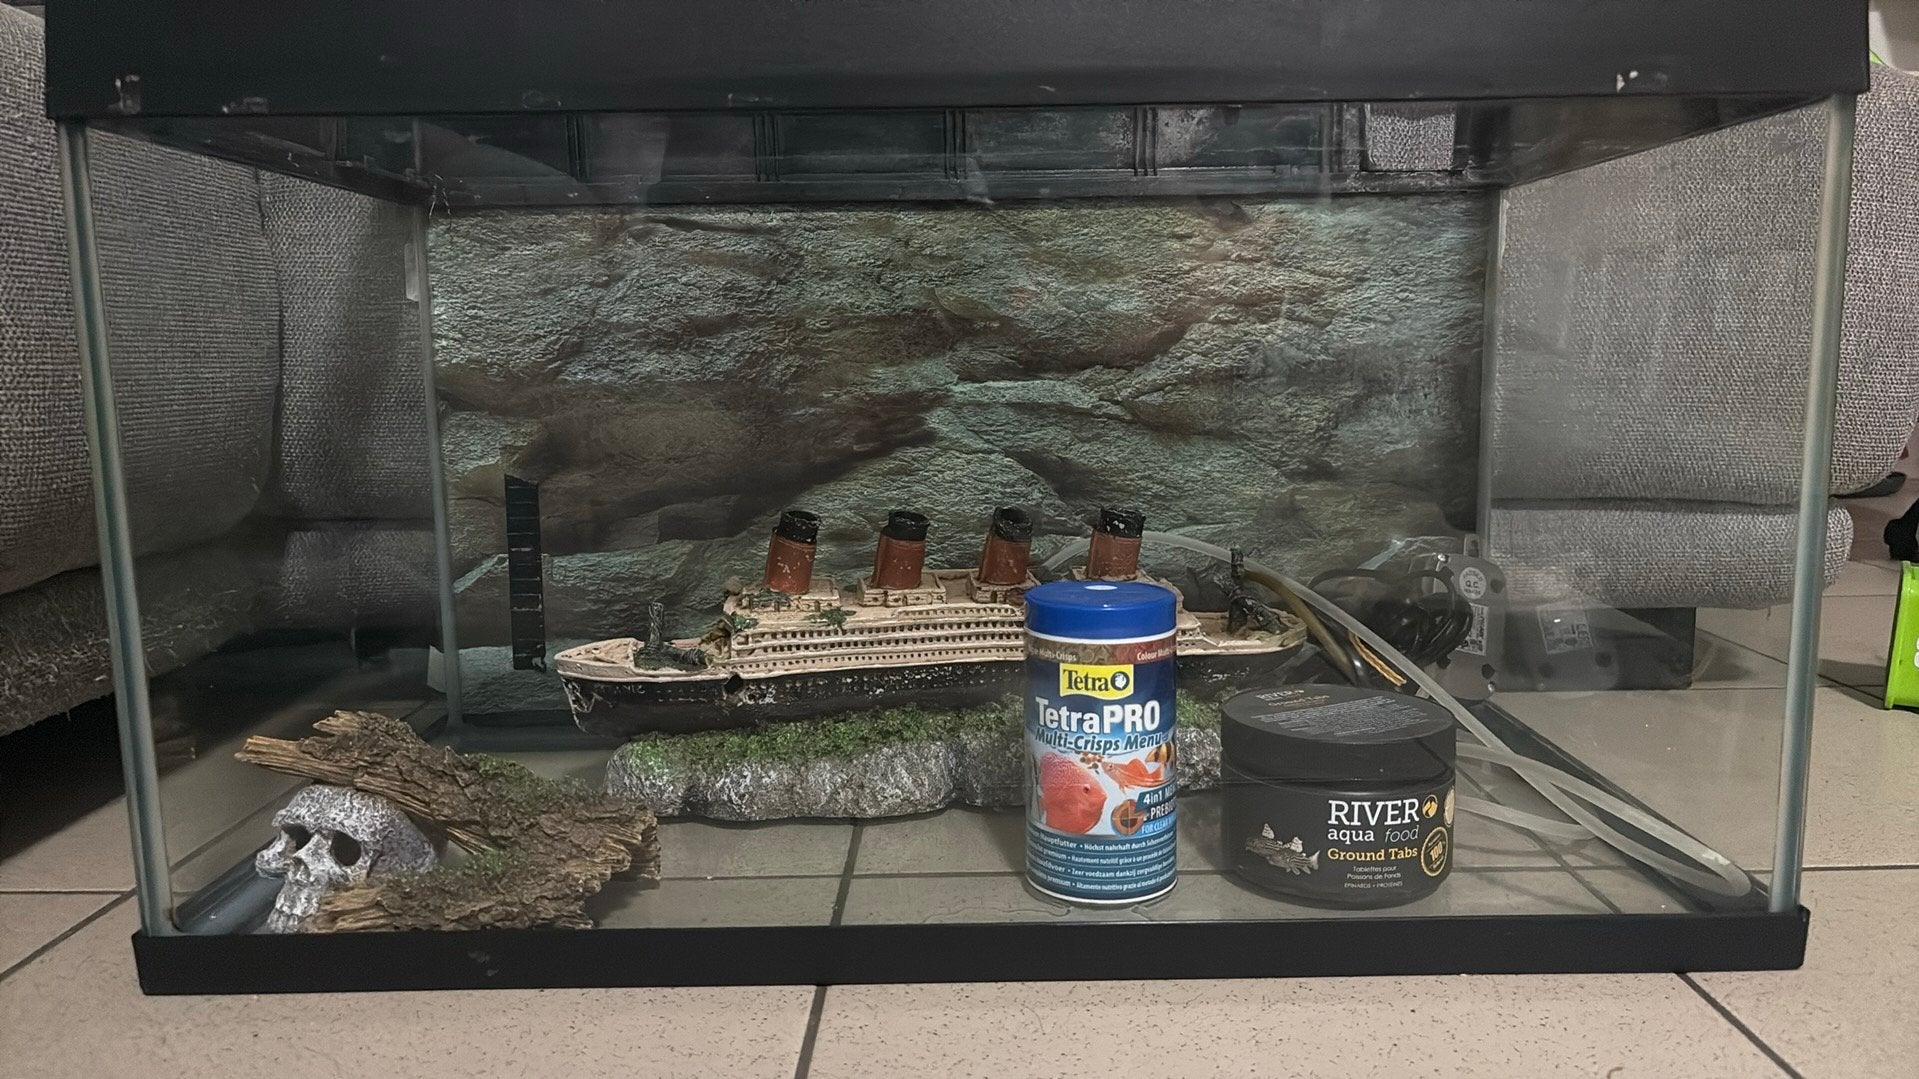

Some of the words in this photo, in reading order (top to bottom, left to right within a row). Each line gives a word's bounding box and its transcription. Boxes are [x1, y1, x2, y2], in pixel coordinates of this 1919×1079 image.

[1136, 650, 1158, 662] Colour
[1063, 669, 1110, 692] Tetra
[1035, 696, 1160, 734] TetraPRO
[1035, 727, 1120, 755] Multi-Crisps
[1124, 732, 1163, 751] Menu
[1143, 790, 1163, 805] 4in1
[1327, 798, 1420, 826] RIVER
[1141, 822, 1154, 834] FOR
[1327, 828, 1375, 844] aqua
[1384, 825, 1420, 843] food
[1327, 848, 1386, 861] Ground
[1388, 847, 1418, 860] Tabs
[1072, 867, 1085, 875] Zeer
[1116, 869, 1136, 877] dankzij
[1353, 866, 1382, 874] Tablettes
[1382, 866, 1397, 874] pour
